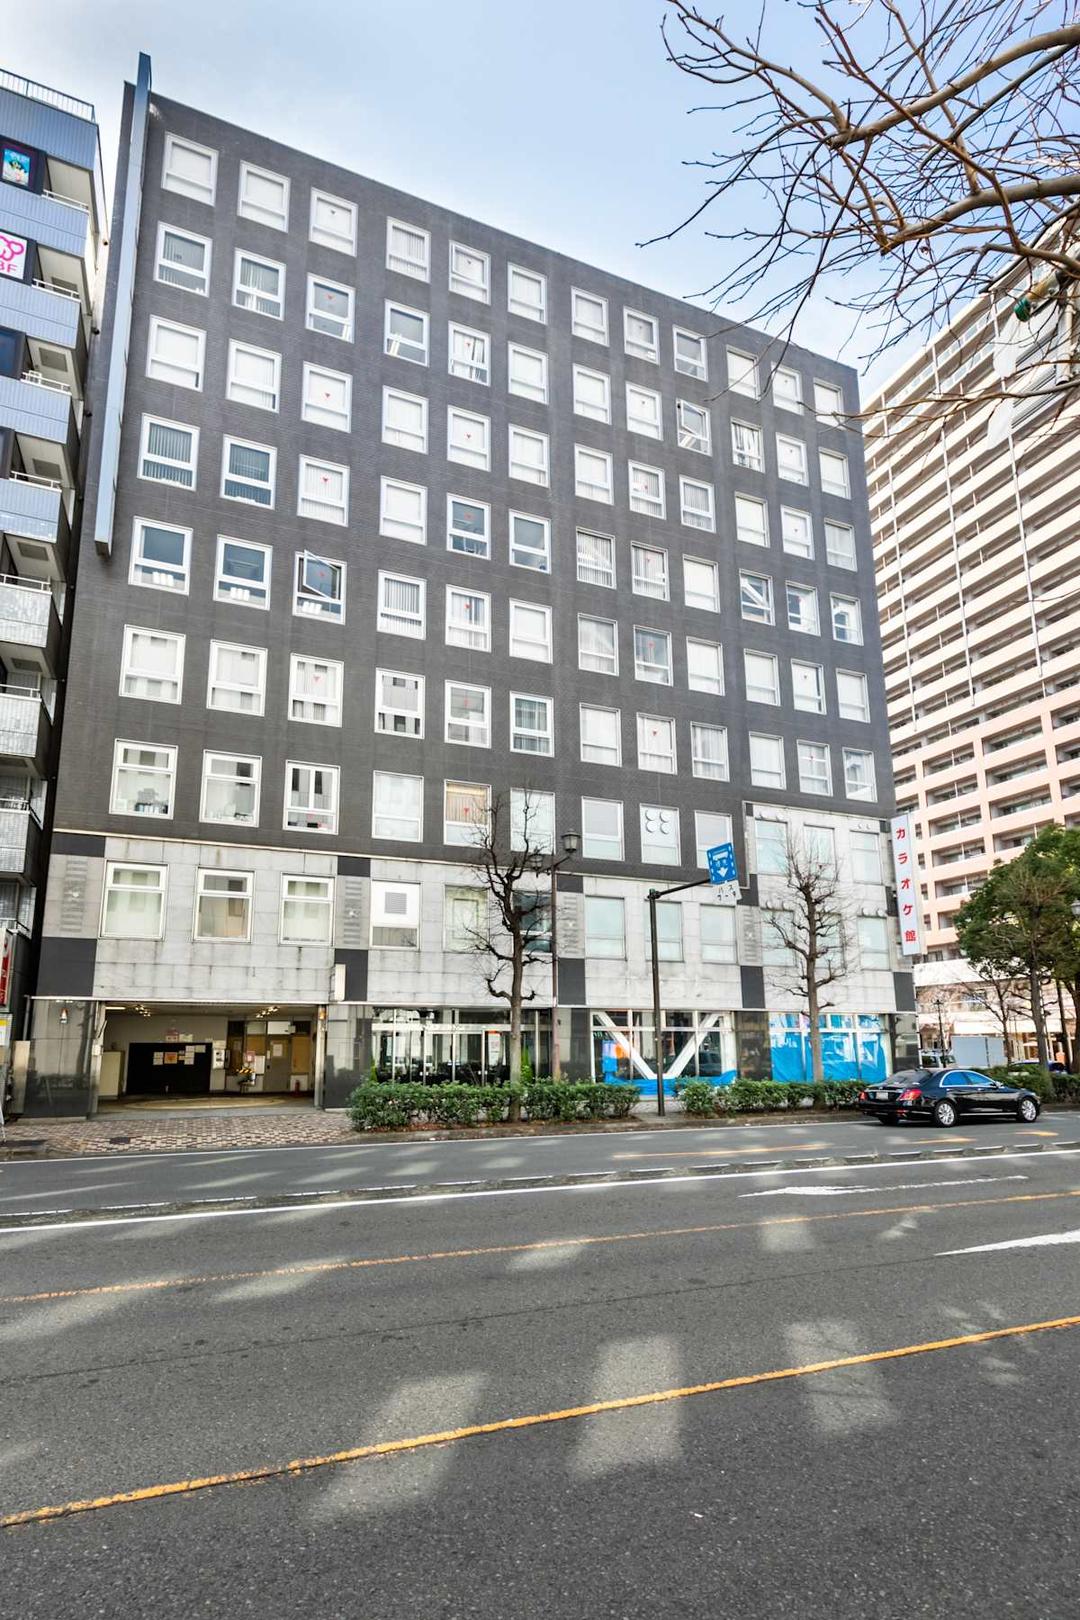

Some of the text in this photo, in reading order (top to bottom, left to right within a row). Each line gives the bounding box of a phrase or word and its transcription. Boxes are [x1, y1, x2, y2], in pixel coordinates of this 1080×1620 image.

[896, 828, 917, 942] カラオケ館
